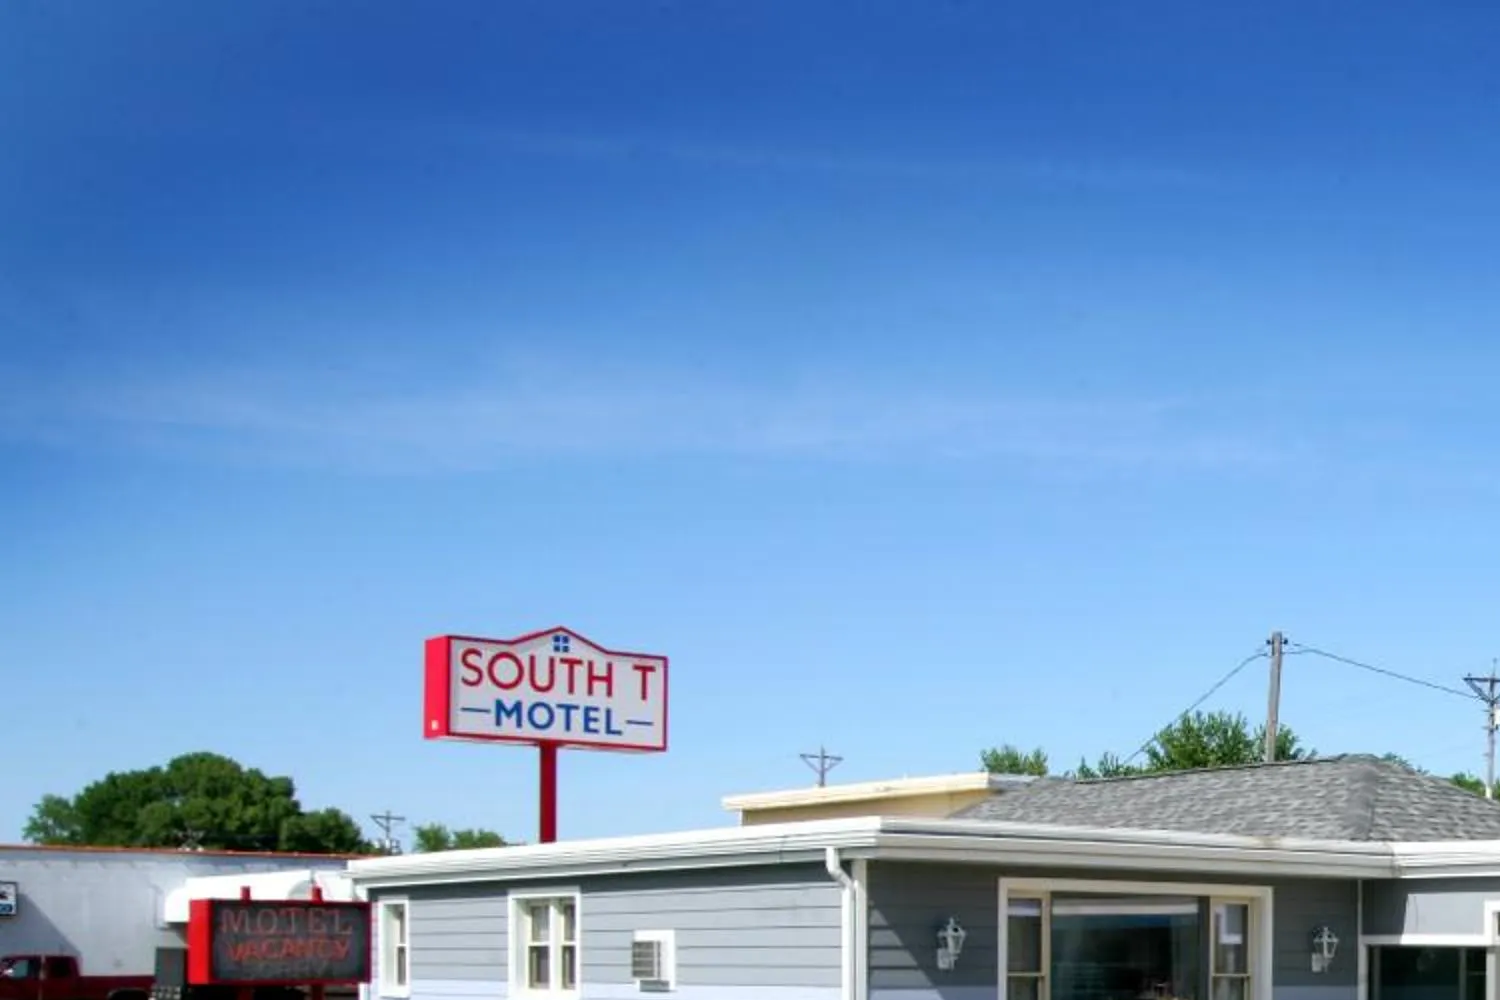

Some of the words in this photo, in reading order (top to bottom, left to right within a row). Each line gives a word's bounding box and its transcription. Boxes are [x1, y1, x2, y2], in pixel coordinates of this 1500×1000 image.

[460, 647, 613, 698] SOUTH
[633, 664, 656, 701] T
[494, 698, 623, 736] MOTEL
[221, 907, 353, 935] MOTEL
[227, 936, 351, 962] VACANCY
